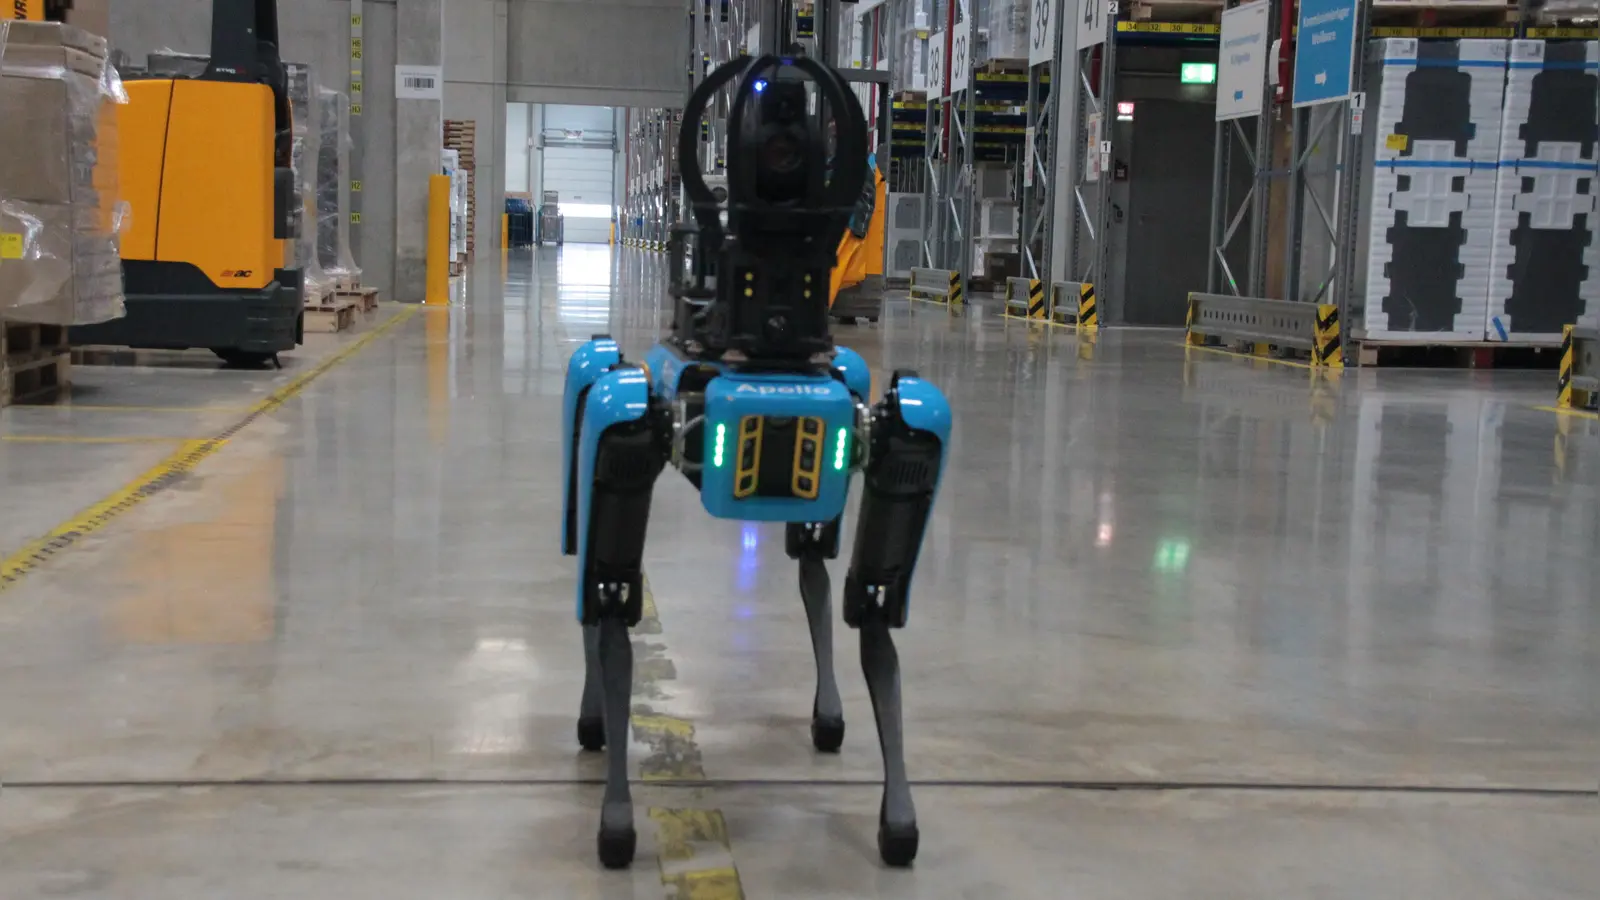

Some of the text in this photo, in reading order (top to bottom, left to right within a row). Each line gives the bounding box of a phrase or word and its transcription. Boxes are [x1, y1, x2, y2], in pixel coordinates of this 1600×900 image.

[1109, 2, 1116, 13] 2
[352, 16, 361, 25] H7
[1084, 0, 1100, 31] 41
[1034, 0, 1050, 50] 39
[1127, 22, 1137, 30] 34
[1150, 23, 1159, 31] 32
[1171, 24, 1181, 32] 30
[955, 35, 966, 79] 39
[970, 58, 976, 67] 2
[930, 46, 940, 88] 38
[351, 83, 361, 92] H4
[1355, 93, 1361, 108] 1
[351, 105, 361, 113] H3
[1103, 141, 1109, 152] 1
[351, 181, 361, 190] H2
[351, 213, 361, 222] H1
[736, 383, 831, 395] Apollo
